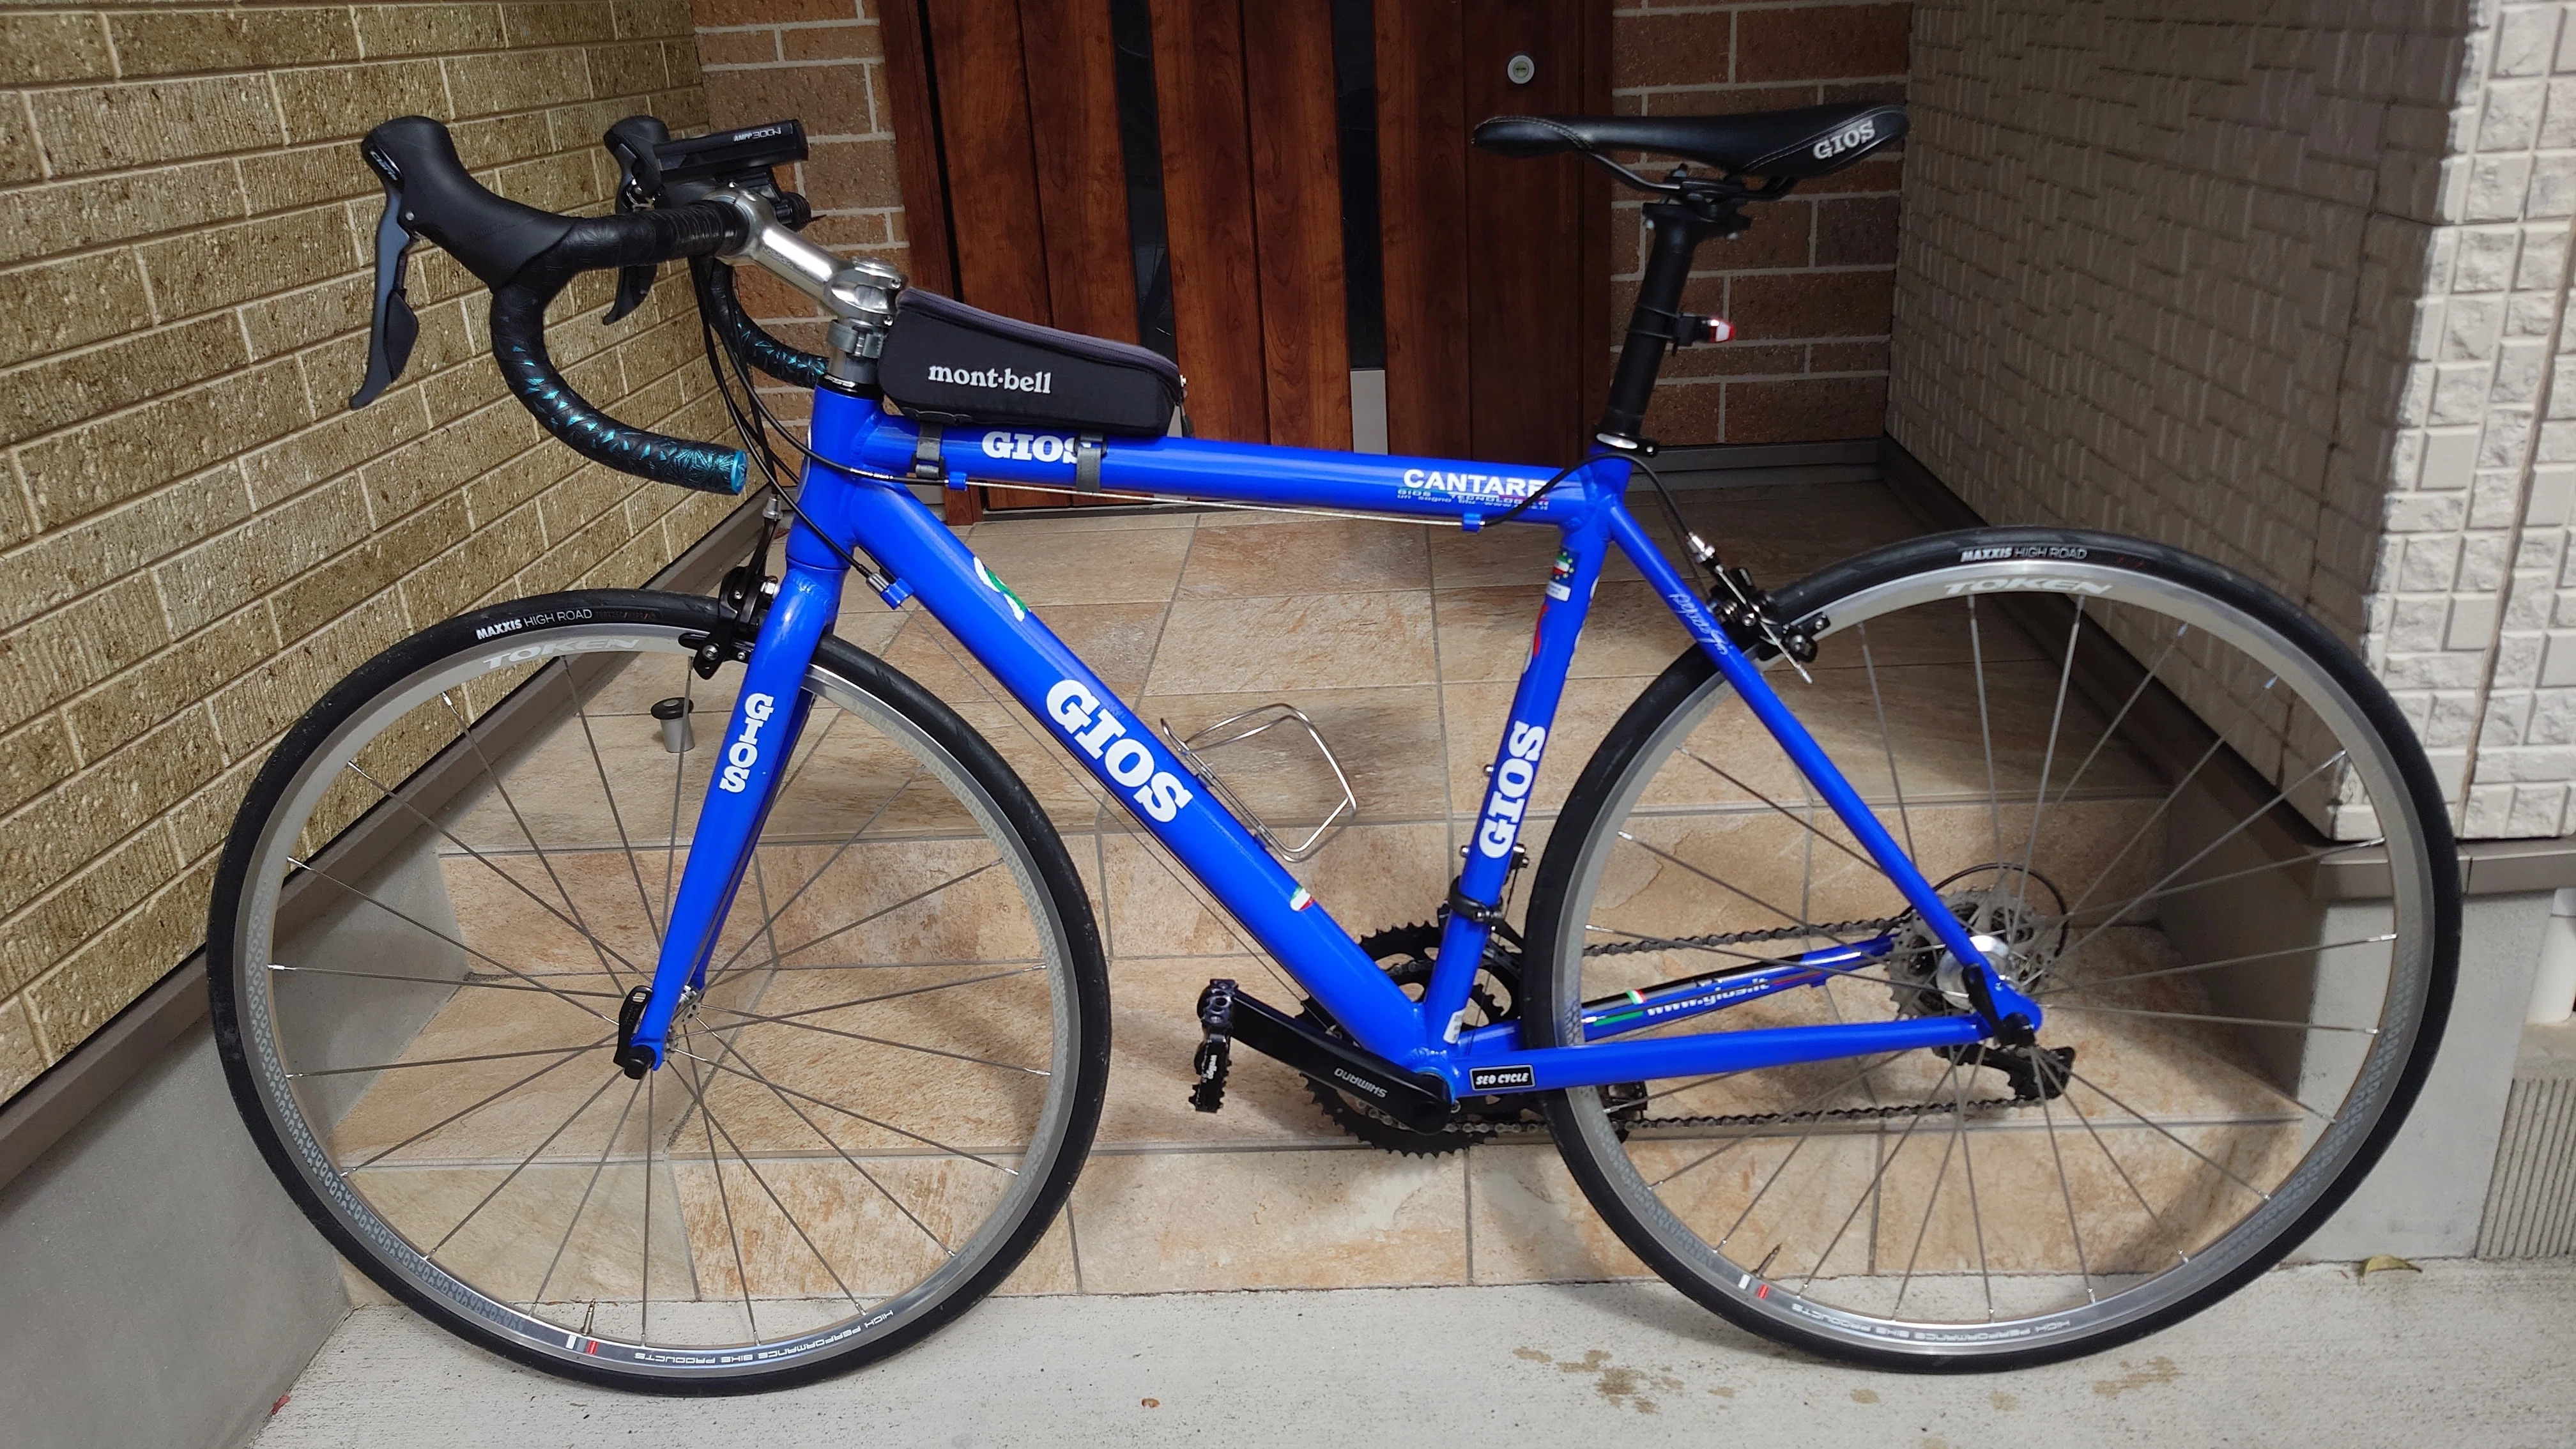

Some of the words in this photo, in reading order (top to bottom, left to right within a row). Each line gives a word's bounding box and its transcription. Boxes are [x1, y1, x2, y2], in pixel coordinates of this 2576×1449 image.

[1813, 120, 1876, 160] GIOS
[1960, 547, 2012, 562] MAXXIS
[2014, 547, 2048, 558] HIGH
[2049, 548, 2087, 560] ROAD
[1943, 578, 2113, 597] TOKEN
[476, 618, 523, 640] MAXXIS
[523, 611, 555, 628] HIGH
[556, 608, 593, 622] ROAD
[483, 639, 640, 670] TOKEN
[719, 693, 774, 793] GIOS
[1046, 679, 1193, 823] GIOS
[1478, 720, 1547, 859] GIOS
[1333, 1067, 1388, 1098] SHIMANO
[1475, 1074, 1496, 1085] SEO
[1498, 1072, 1529, 1084] CYCLE
[864, 1310, 894, 1329] HIGH
[758, 1324, 862, 1360] PERFORMANCE
[634, 1352, 716, 1365] PRODUCTS
[721, 1354, 755, 1363] BIKE
